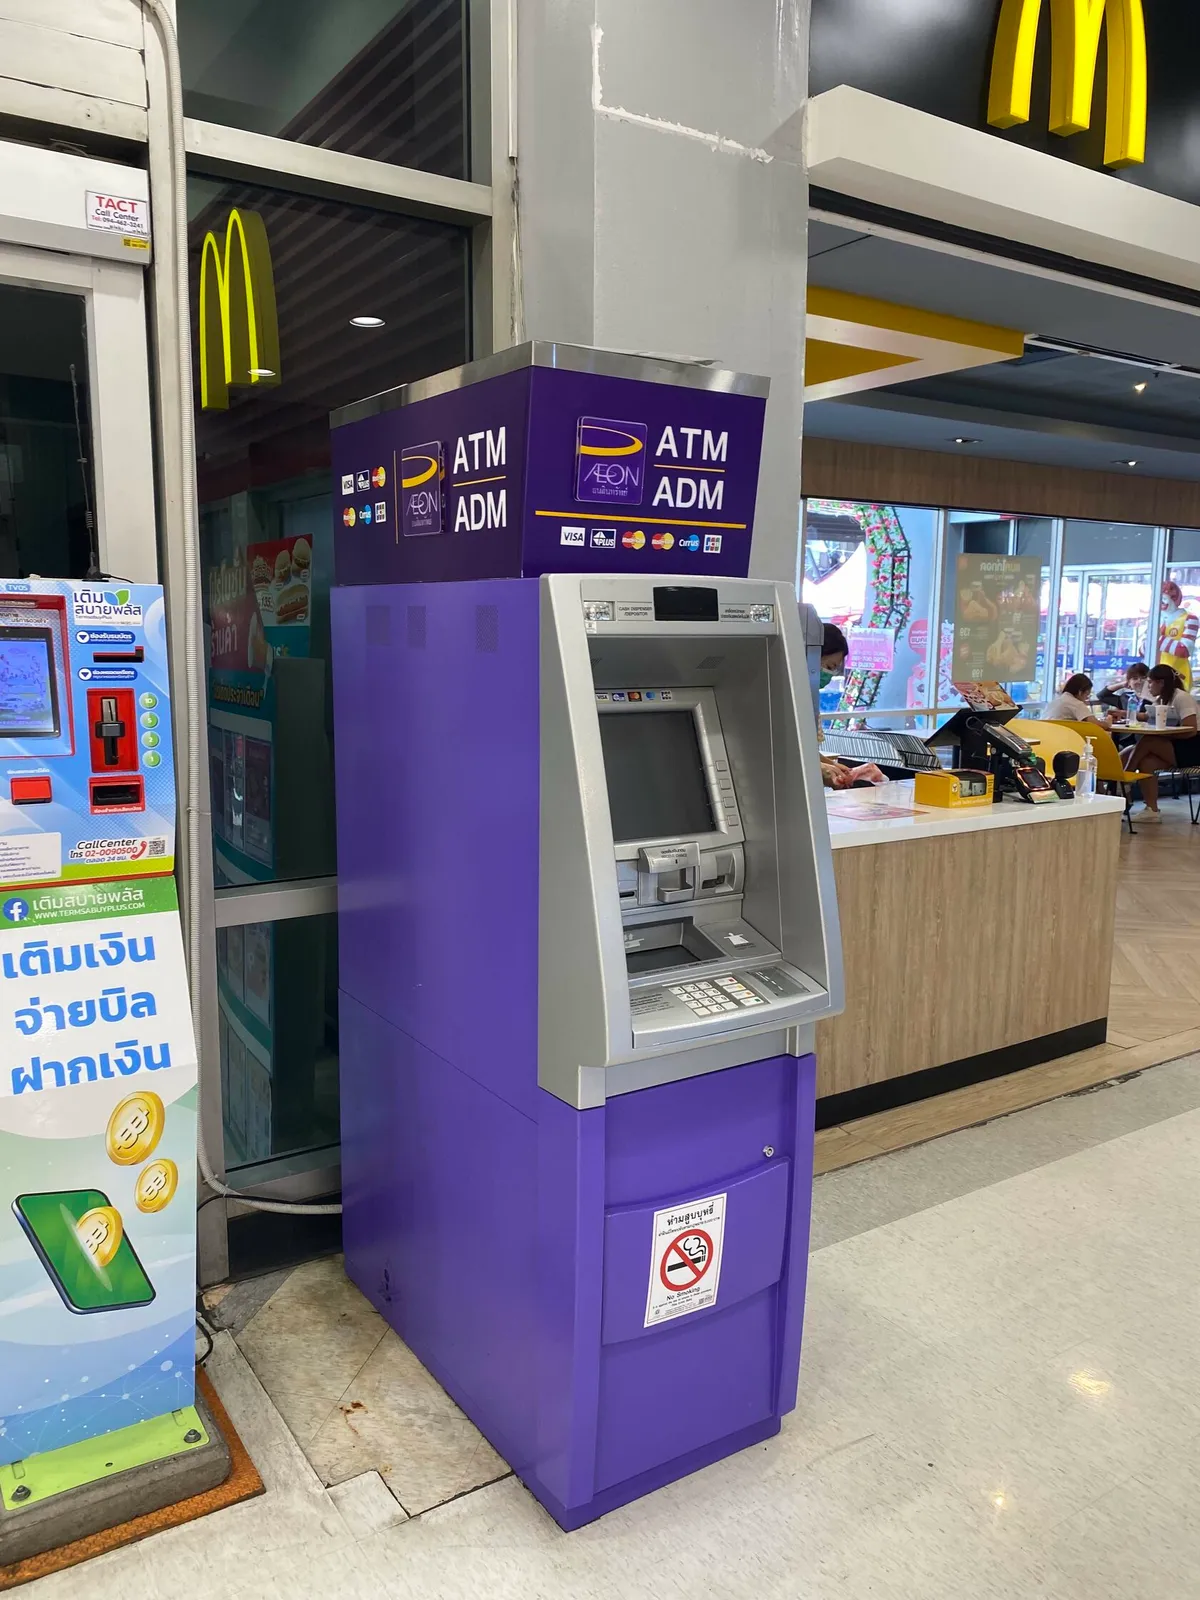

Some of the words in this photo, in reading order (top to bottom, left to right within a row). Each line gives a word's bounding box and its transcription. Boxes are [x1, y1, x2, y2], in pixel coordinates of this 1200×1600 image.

[95, 195, 138, 213] TACT
[95, 208, 110, 217] Call
[113, 211, 139, 222] Center
[453, 426, 506, 475] ATM
[655, 425, 728, 462] ATM
[651, 475, 724, 510] ADM
[454, 489, 507, 532] ADM
[563, 532, 584, 542] VISA
[598, 538, 614, 547] PLUS
[678, 538, 700, 547] Cirrus
[73, 589, 104, 604] เติม
[75, 603, 142, 616] สบายพลัส
[1110, 657, 1123, 667] 24
[70, 850, 83, 858] โทร
[84, 846, 138, 857] 02-0090500
[77, 839, 137, 850] CallCenter
[33, 887, 144, 911] เติมสบายพลัส
[34, 902, 146, 920] WWW.TERMSABUYPLUS.COM
[2, 931, 155, 979] เติมเงิน
[15, 987, 157, 1035] จ่ายบิล
[11, 1039, 171, 1095] ฝากเงิน
[666, 1201, 715, 1226] ห้ามสูบบุหรี่
[666, 1294, 675, 1302] No
[676, 1286, 701, 1299] Smoking
